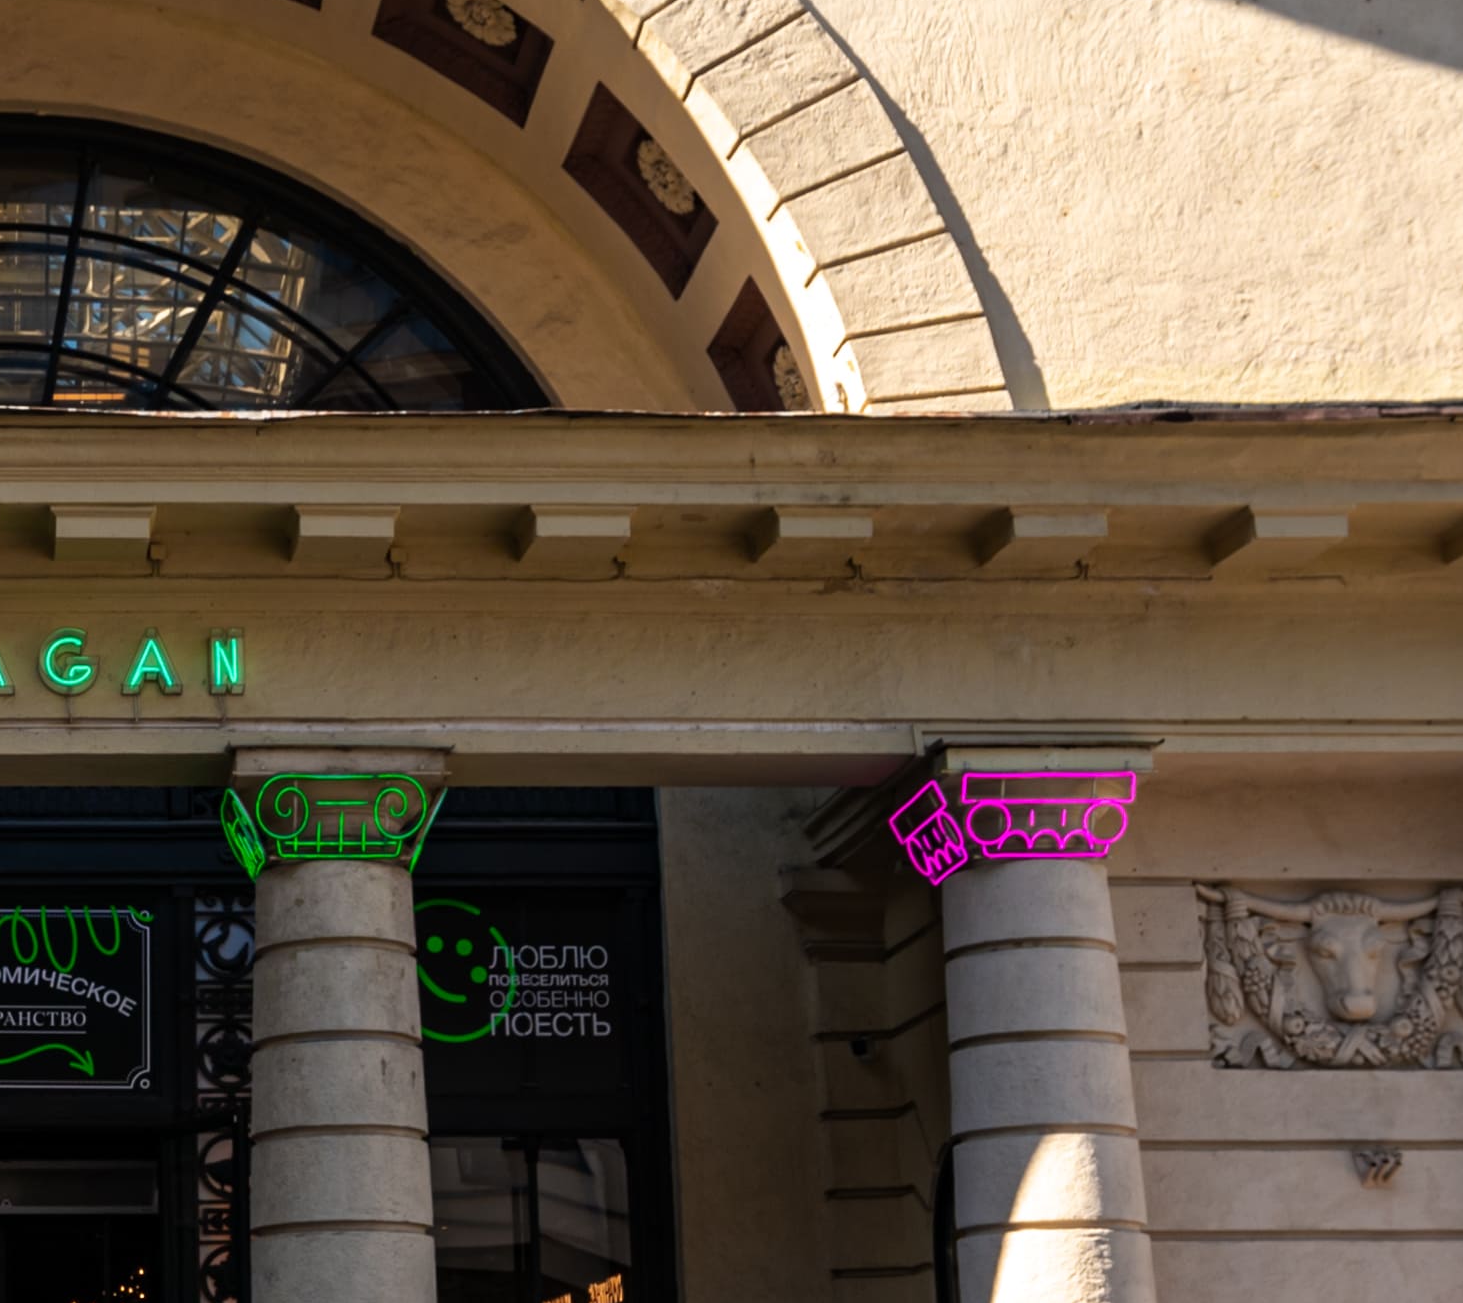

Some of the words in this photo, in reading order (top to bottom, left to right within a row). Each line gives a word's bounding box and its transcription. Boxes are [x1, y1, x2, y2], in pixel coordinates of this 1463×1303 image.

[488, 945, 609, 970] ЛЮБЛЮ
[488, 973, 609, 987] ПОВЕСЕЛИТЬСЯ
[489, 989, 610, 1008] ОСОБЕННО
[490, 1011, 612, 1037] ПОЕСТЬ
